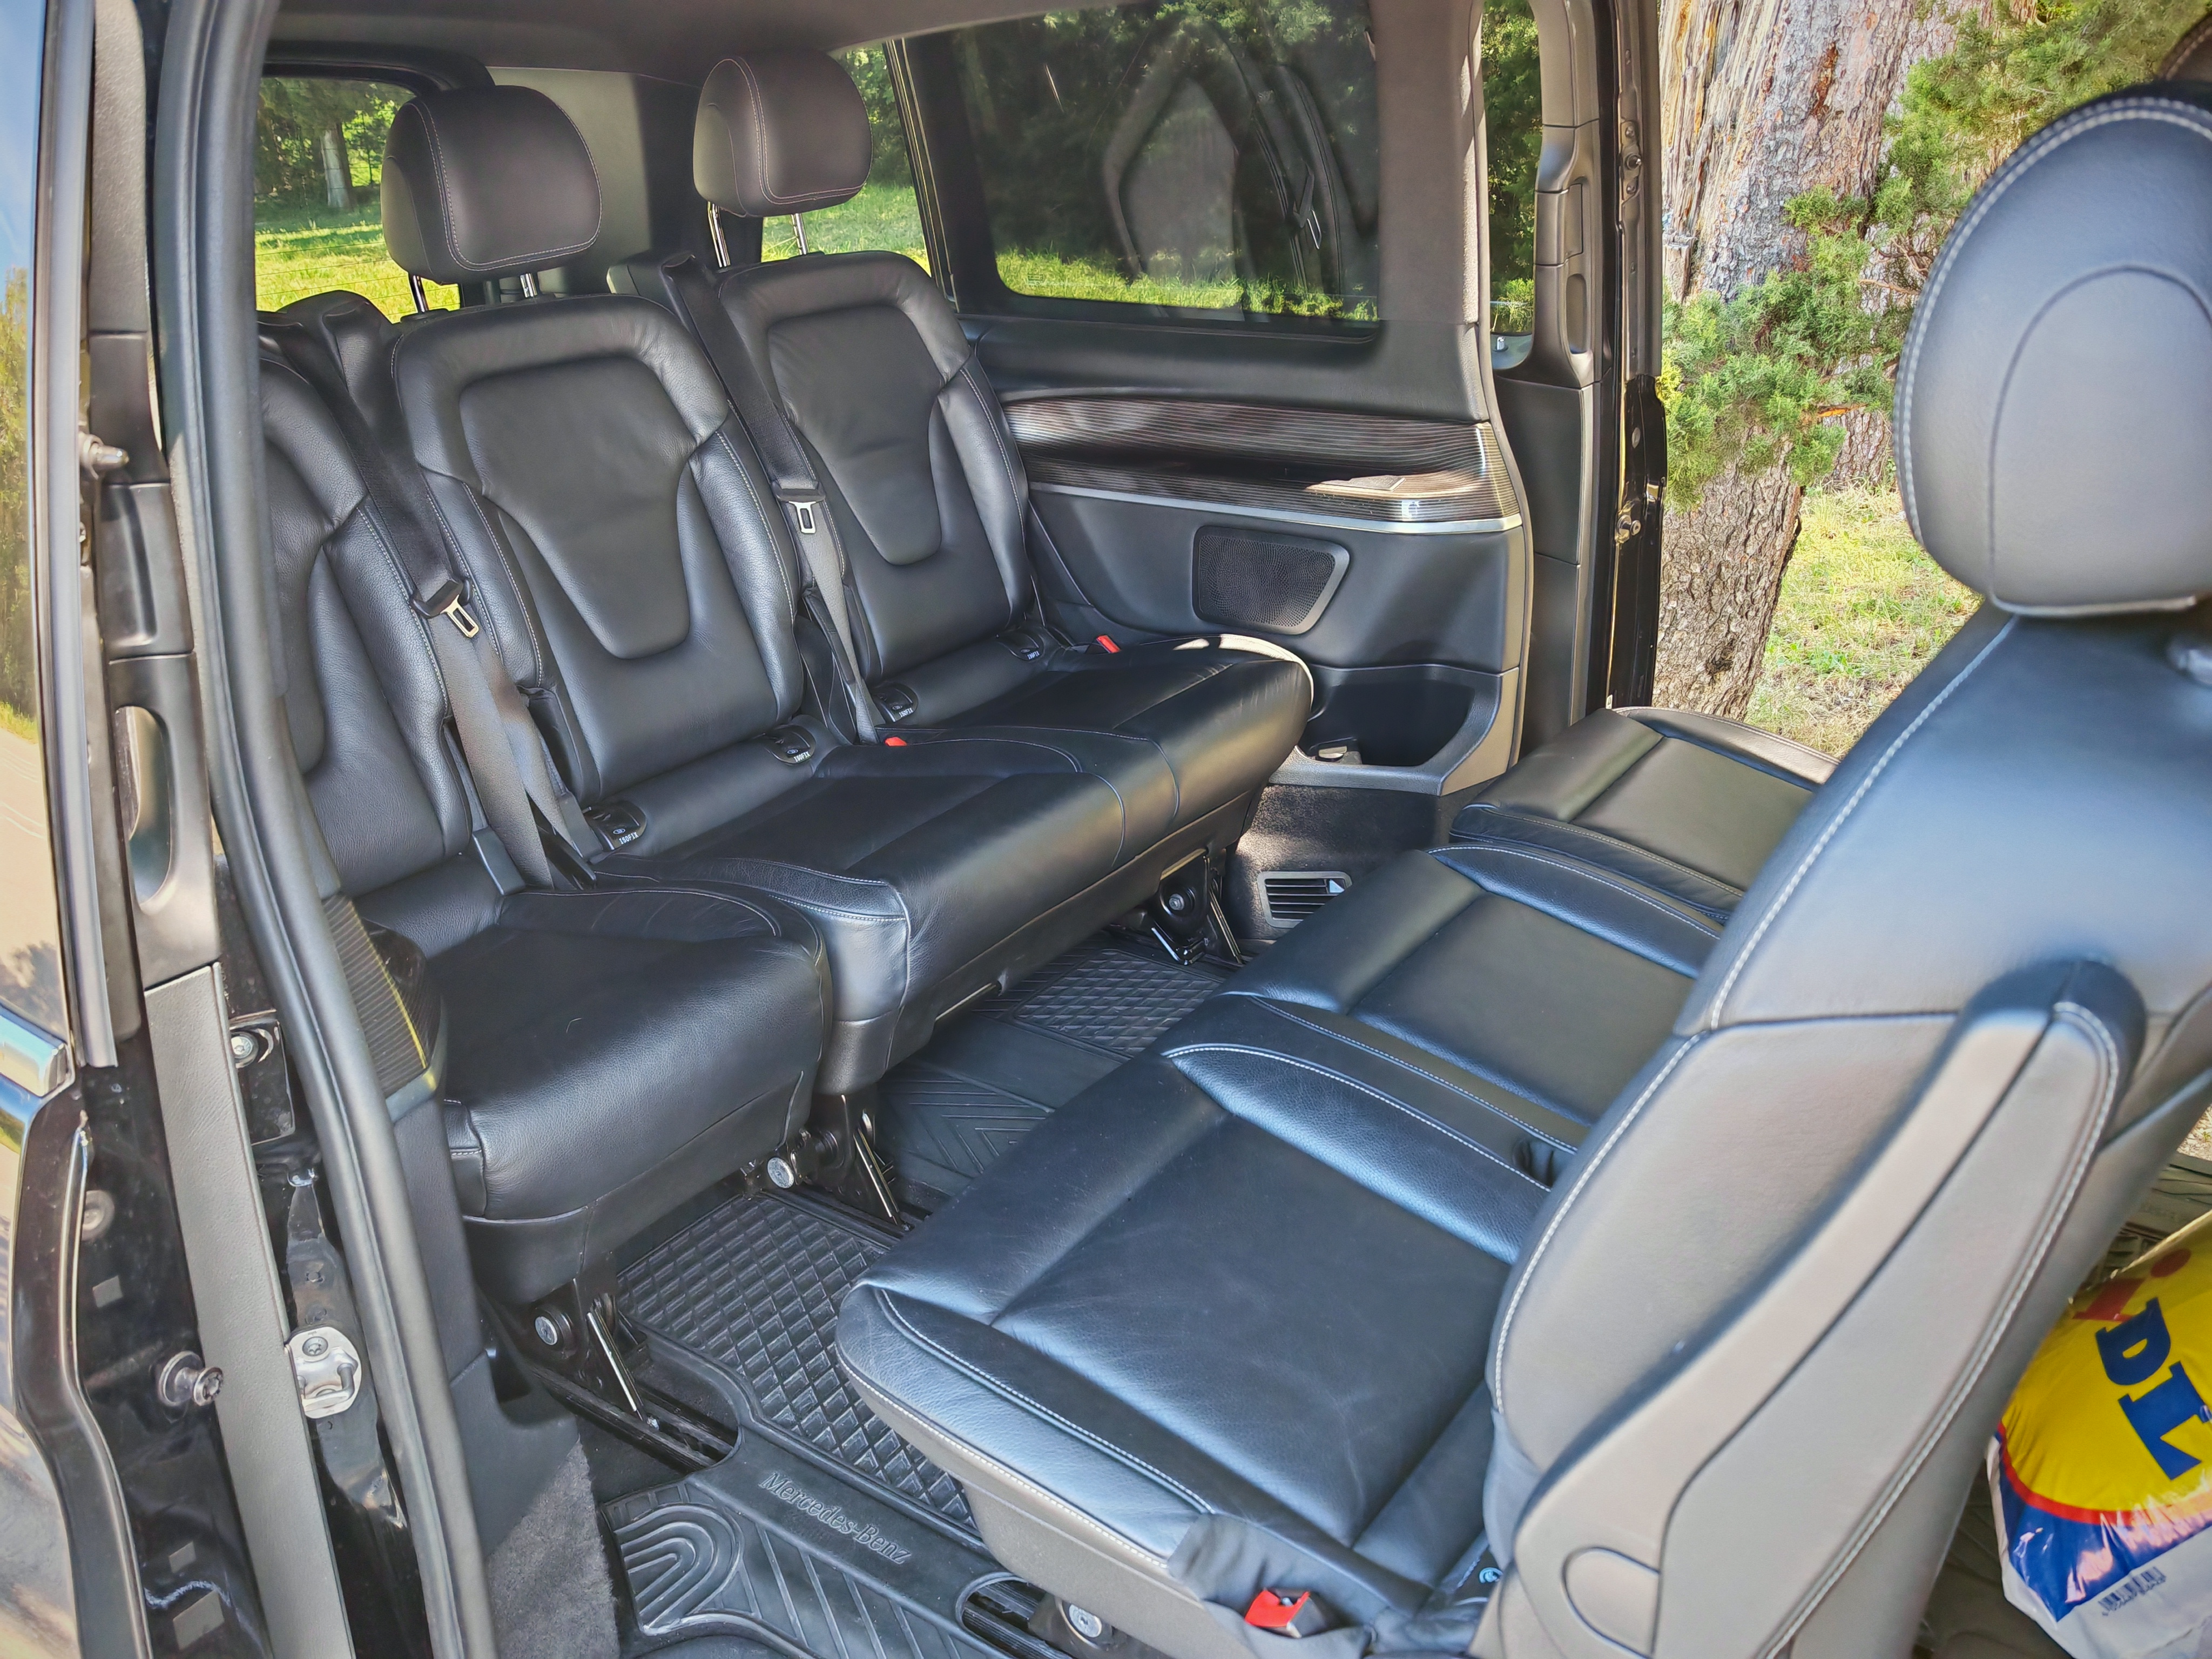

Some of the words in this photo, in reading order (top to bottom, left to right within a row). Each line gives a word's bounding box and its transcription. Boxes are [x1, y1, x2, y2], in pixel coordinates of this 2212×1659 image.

[899, 707, 914, 718] ISOFIX
[793, 751, 811, 763] ISOFIX
[619, 832, 639, 845] ISOFIX
[758, 1471, 912, 1564] Mercedes-Benz
